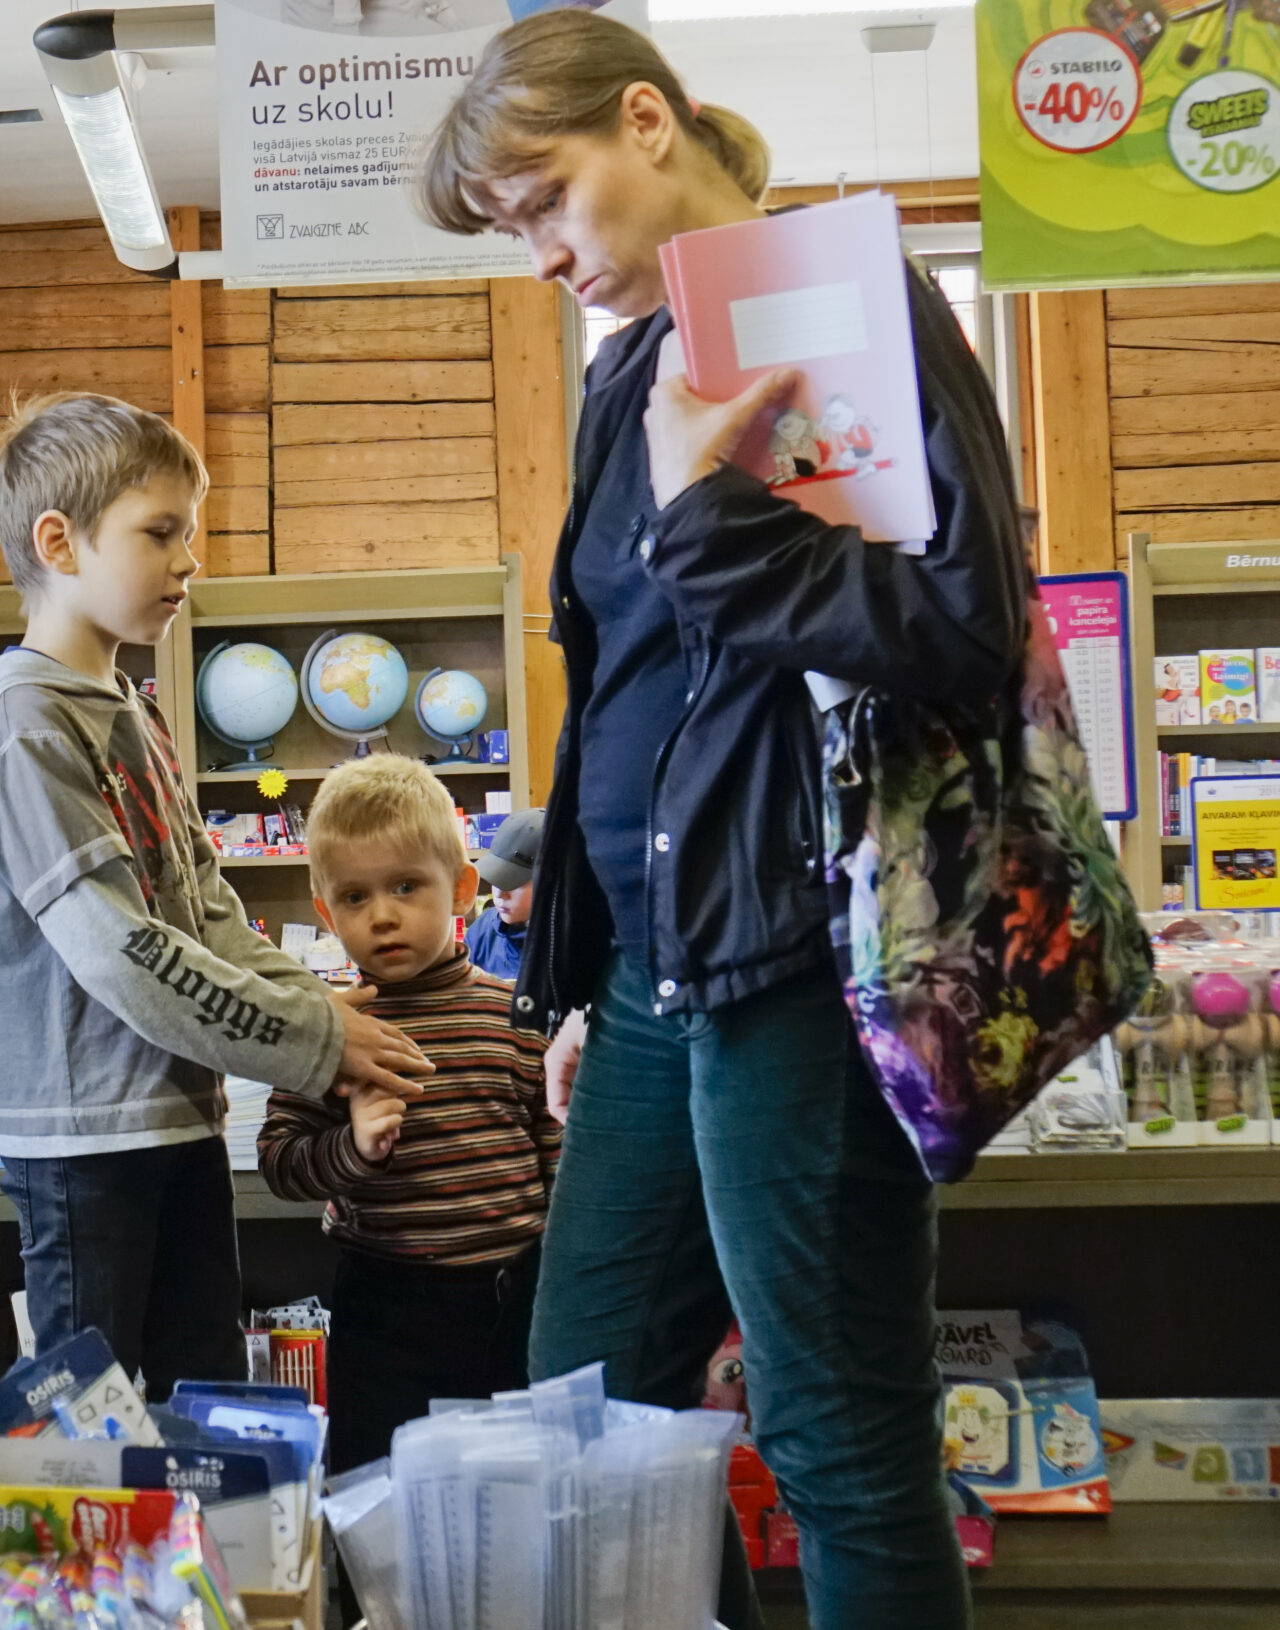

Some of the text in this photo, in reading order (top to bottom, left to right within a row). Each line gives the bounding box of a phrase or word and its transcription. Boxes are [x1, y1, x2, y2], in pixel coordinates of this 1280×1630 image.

[249, 52, 474, 90] Ar optimismu
[1049, 60, 1122, 75] STABILO
[251, 91, 395, 125] uz skolu!
[1024, 81, 1124, 124] -40%
[253, 138, 312, 153] Iegādājies
[315, 136, 352, 148] skolas
[356, 135, 395, 147] preces
[253, 152, 276, 165] visā
[279, 151, 317, 164] Latvijā
[320, 150, 361, 161] vismaz
[364, 148, 378, 159] 25
[382, 147, 406, 158] EUR
[1186, 141, 1275, 177] -20%
[254, 166, 301, 178] dāvanu:
[304, 163, 359, 175] nelaimes
[254, 183, 269, 192] un
[272, 178, 337, 191] atstarotāju
[340, 178, 379, 188] savam
[347, 221, 370, 236] ABC
[120, 928, 288, 1046] Bloggs
[26, 1369, 75, 1406] OSIRIS
[166, 1469, 221, 1488] OSIRIS
